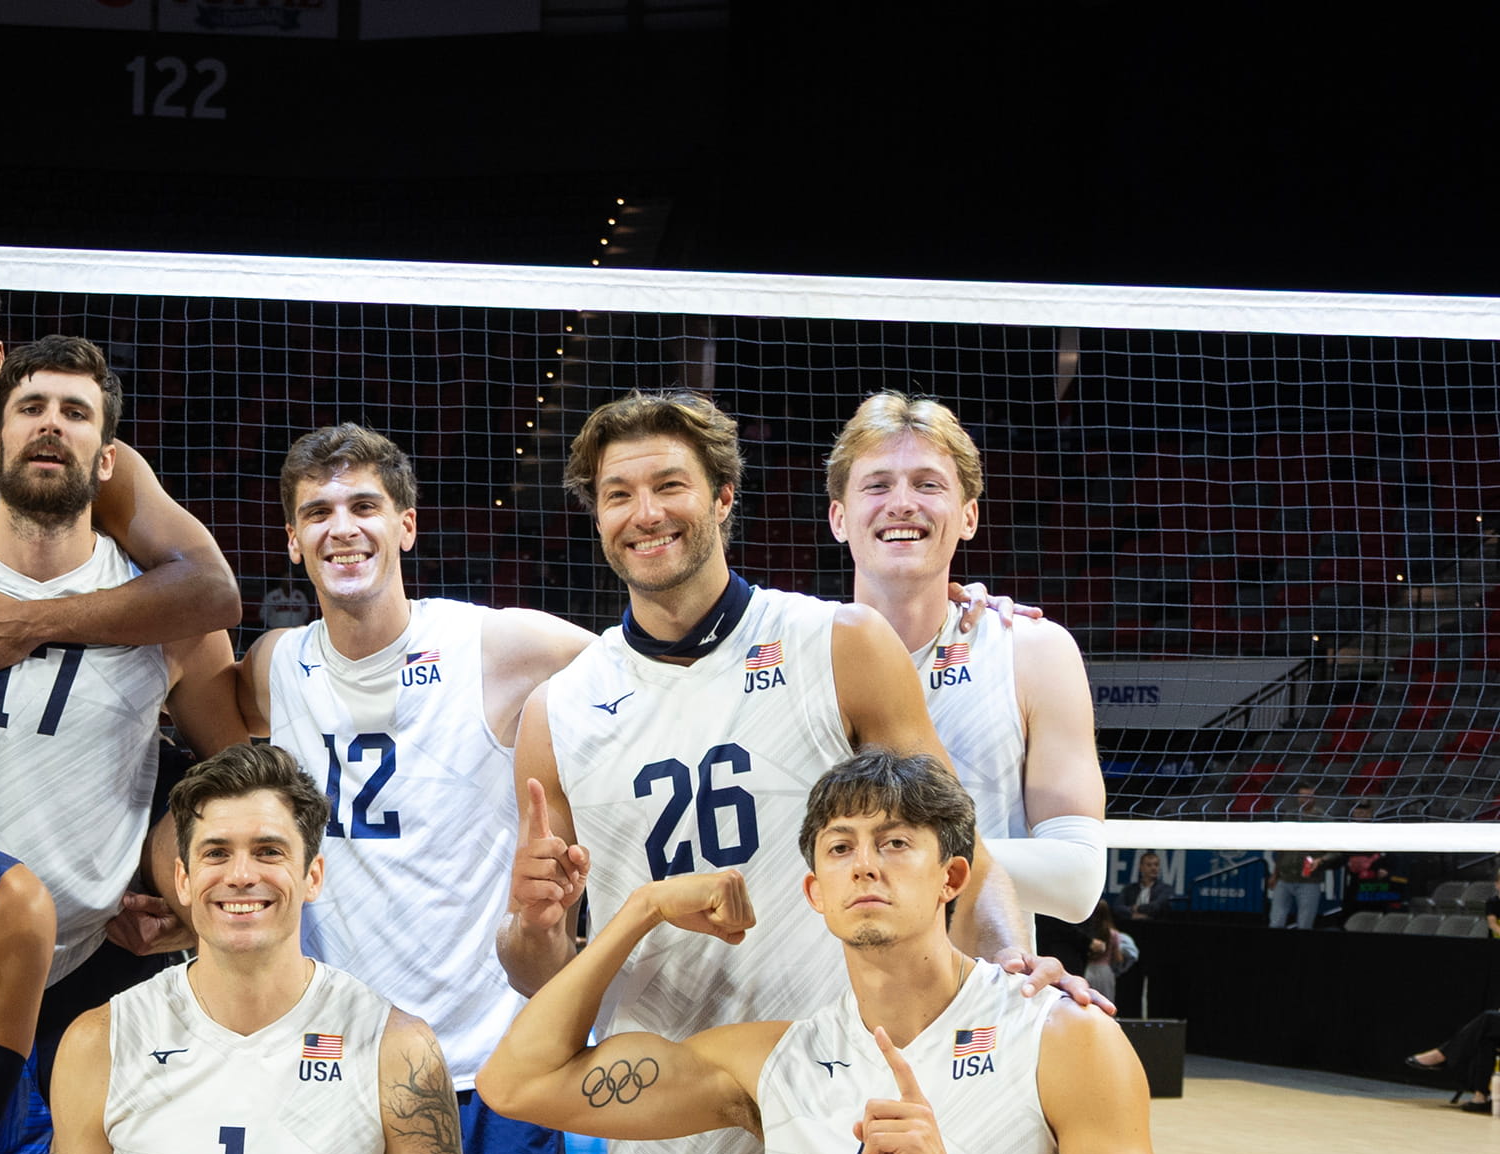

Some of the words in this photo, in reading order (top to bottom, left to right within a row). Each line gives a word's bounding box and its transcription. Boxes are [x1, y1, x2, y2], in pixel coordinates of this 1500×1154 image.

[124, 56, 227, 120] 122
[402, 664, 441, 687] USA
[744, 667, 786, 694] USA
[929, 666, 972, 690] USA
[1097, 686, 1159, 703] PARTS
[321, 733, 400, 839] 12
[633, 742, 759, 882] 26
[299, 1060, 342, 1082] USA
[952, 1054, 995, 1080] USA
